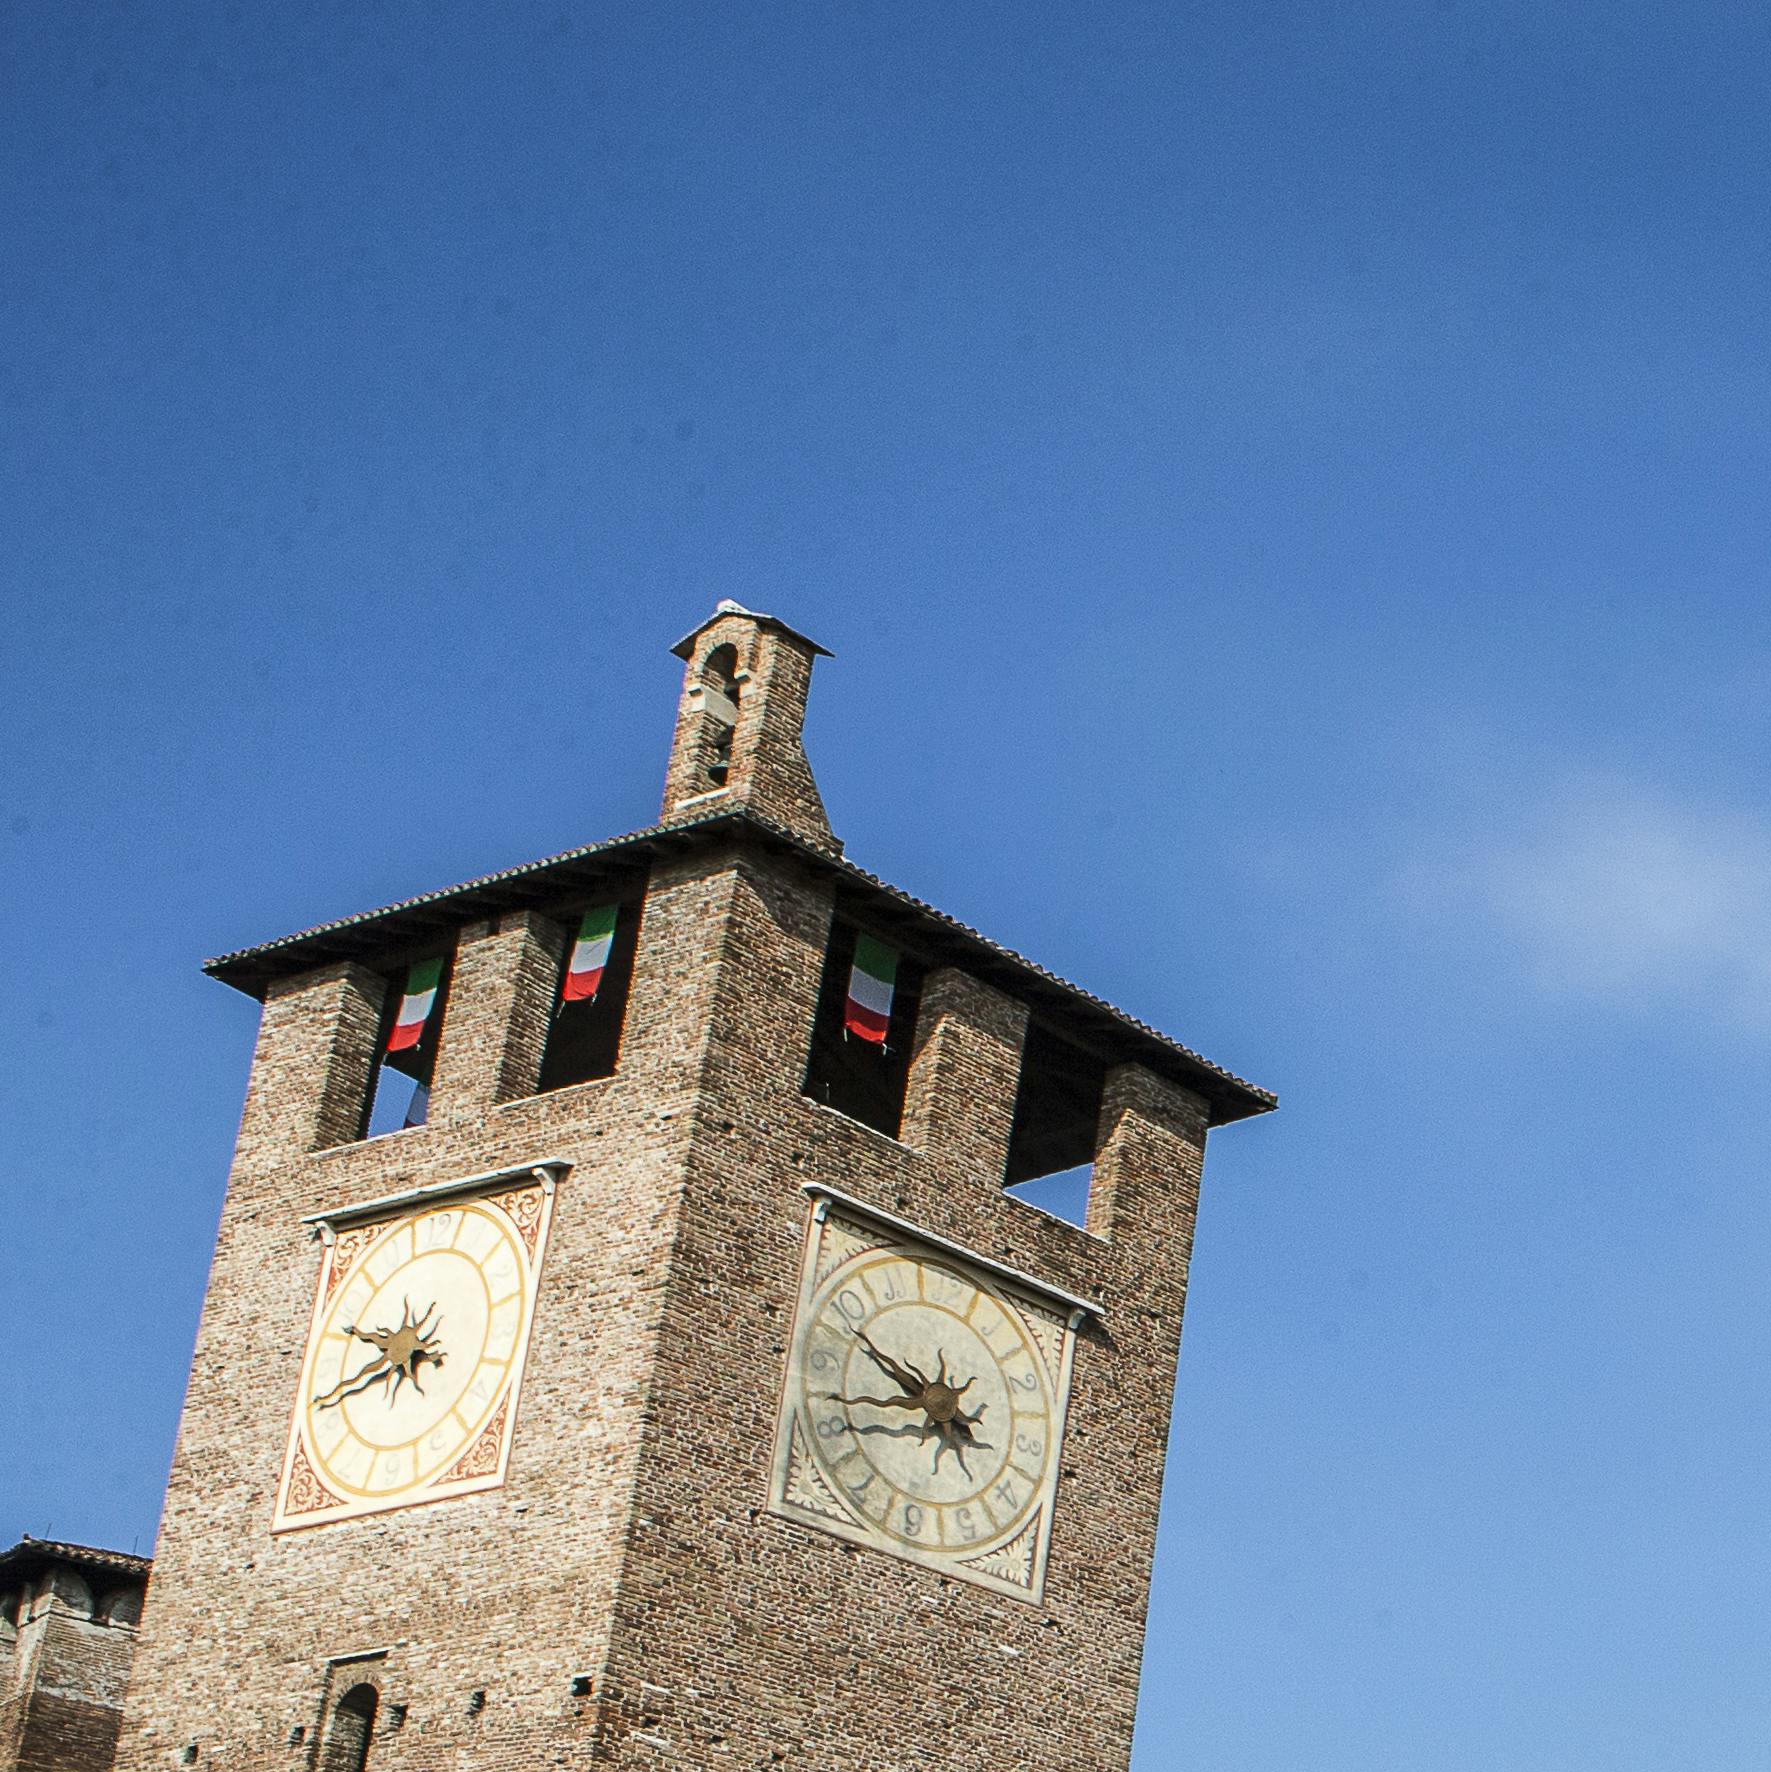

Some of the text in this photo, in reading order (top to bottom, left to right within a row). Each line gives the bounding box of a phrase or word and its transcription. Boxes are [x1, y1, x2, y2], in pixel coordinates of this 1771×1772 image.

[830, 1288, 866, 1336] 10
[1009, 1372, 1038, 1395] 2
[816, 1414, 848, 1440] 8
[1014, 1433, 1043, 1457] 3
[995, 1479, 1019, 1511] 4
[904, 1504, 924, 1537] 6
